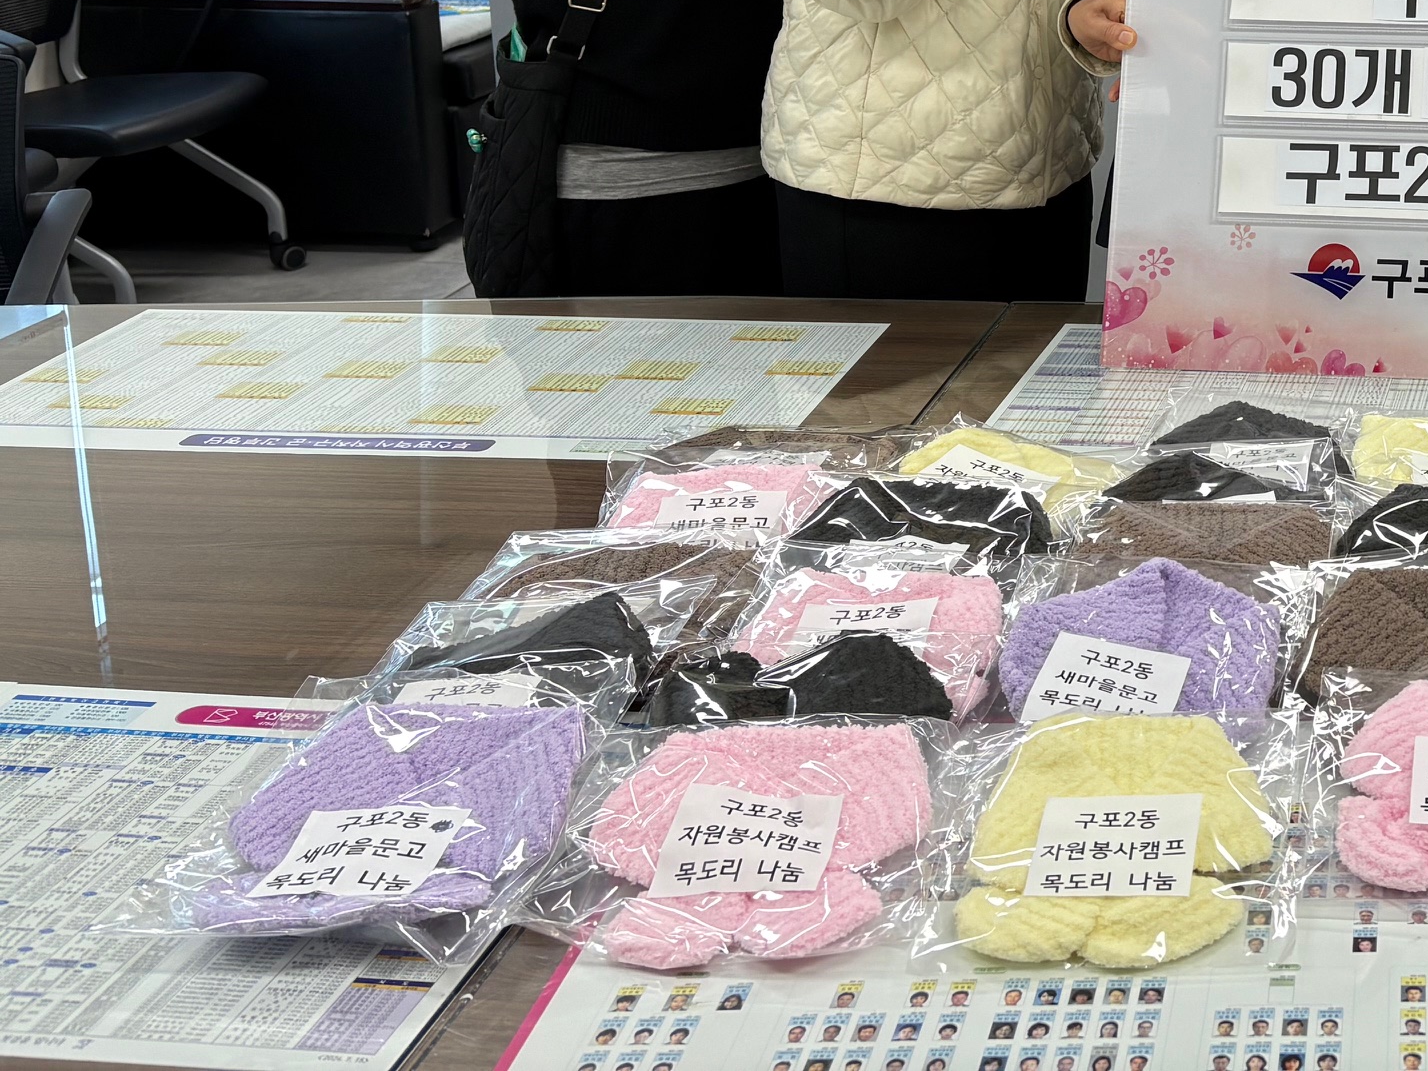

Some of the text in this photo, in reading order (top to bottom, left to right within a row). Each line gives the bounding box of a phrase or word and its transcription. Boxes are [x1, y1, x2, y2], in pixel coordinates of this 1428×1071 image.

[1270, 47, 1412, 117] 30개
[970, 459, 1025, 483] 구포2동
[686, 495, 759, 511] 구포2동
[830, 605, 906, 626] 구포2동
[1081, 649, 1154, 680] 구포2동
[424, 681, 502, 701] 구포2동
[1055, 669, 1159, 704] 새마을문고
[1039, 689, 1102, 712] 목도리
[338, 811, 434, 833] 구포2동
[720, 798, 804, 827] 구포2동
[1073, 808, 1162, 831] 구포2동
[296, 837, 427, 863] 새마을문고
[677, 825, 822, 855] 자원봉사캠프
[1040, 837, 1187, 865] 자원봉사캠프
[265, 866, 413, 892] 목도리 나눔
[673, 856, 805, 886] 목도리 나눔
[1039, 866, 1178, 894] 목도리 나눔
